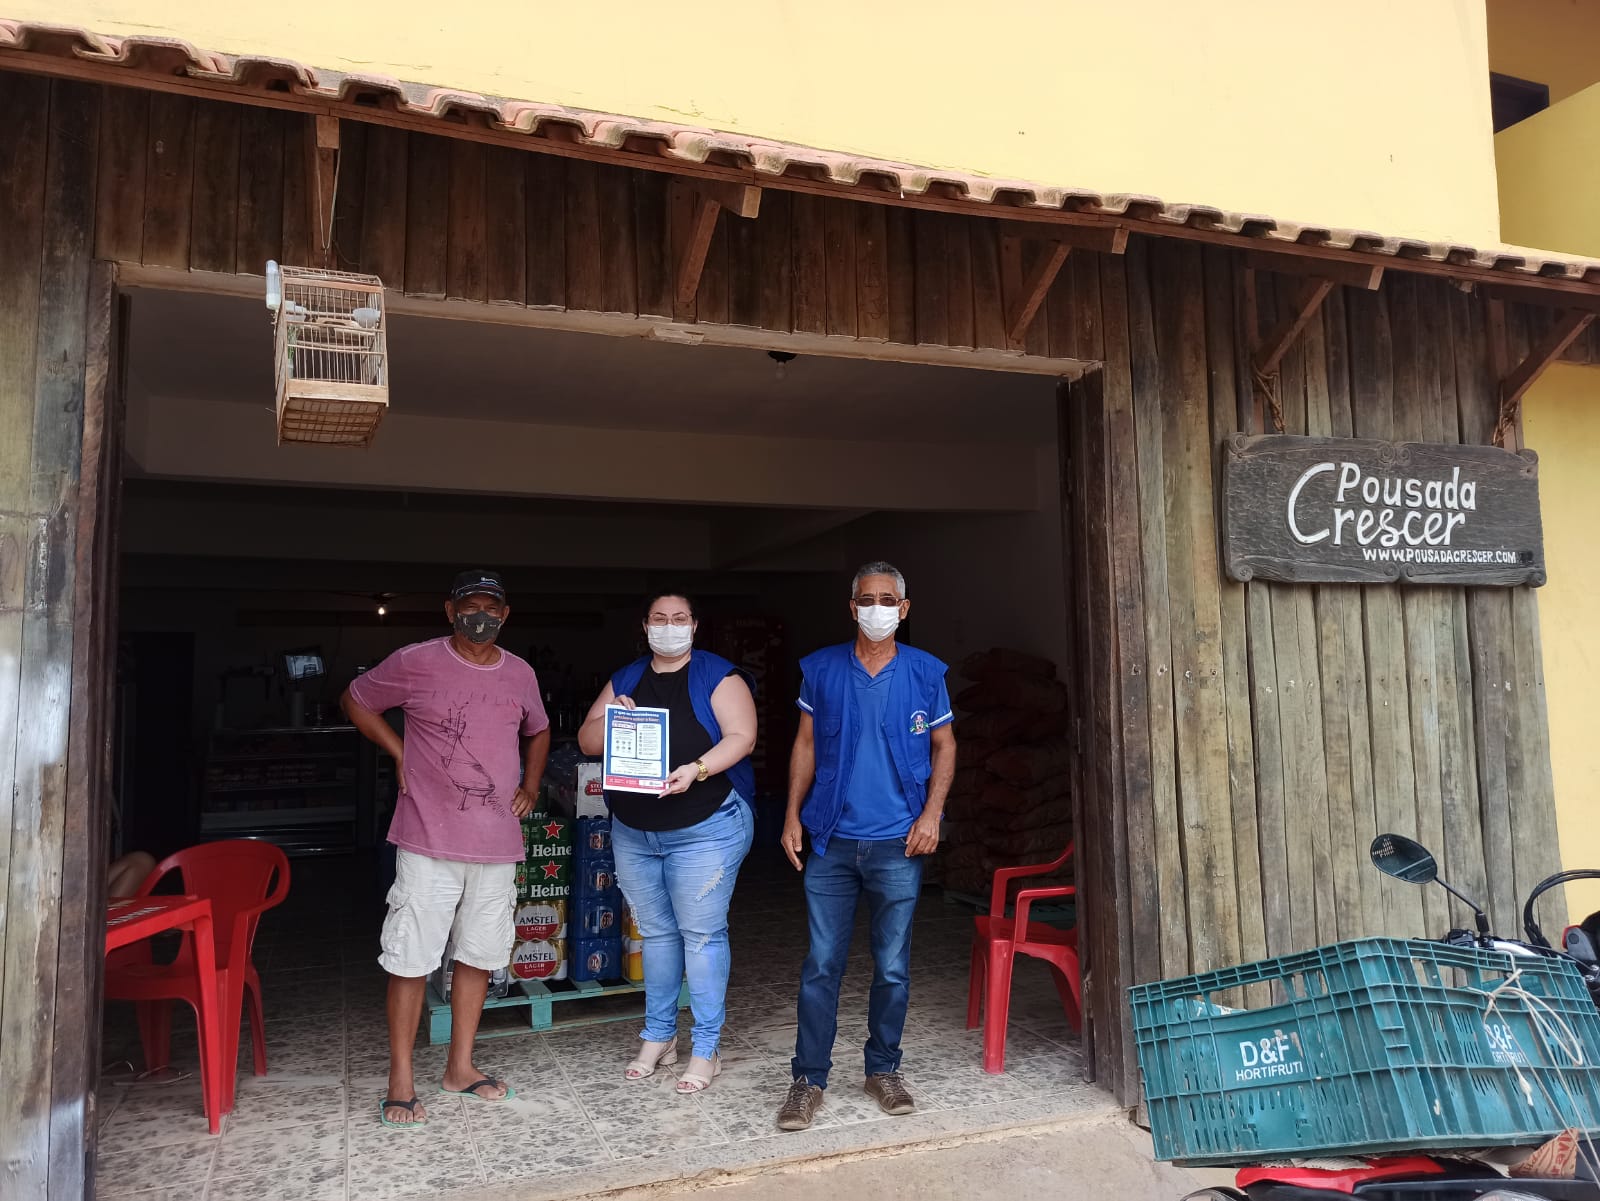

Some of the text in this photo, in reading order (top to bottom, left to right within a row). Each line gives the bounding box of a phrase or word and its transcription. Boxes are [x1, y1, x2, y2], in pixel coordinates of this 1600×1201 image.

[1336, 462, 1476, 510] Pousada
[1288, 463, 1466, 546] Crescer
[1362, 548, 1517, 564] WWW.POUSADACRESCER.COM
[519, 915, 555, 925] AMSTEL
[516, 952, 554, 964] AMSTEL
[1239, 1034, 1290, 1067] D&F
[1235, 1061, 1304, 1081] HORTIFRUTI
